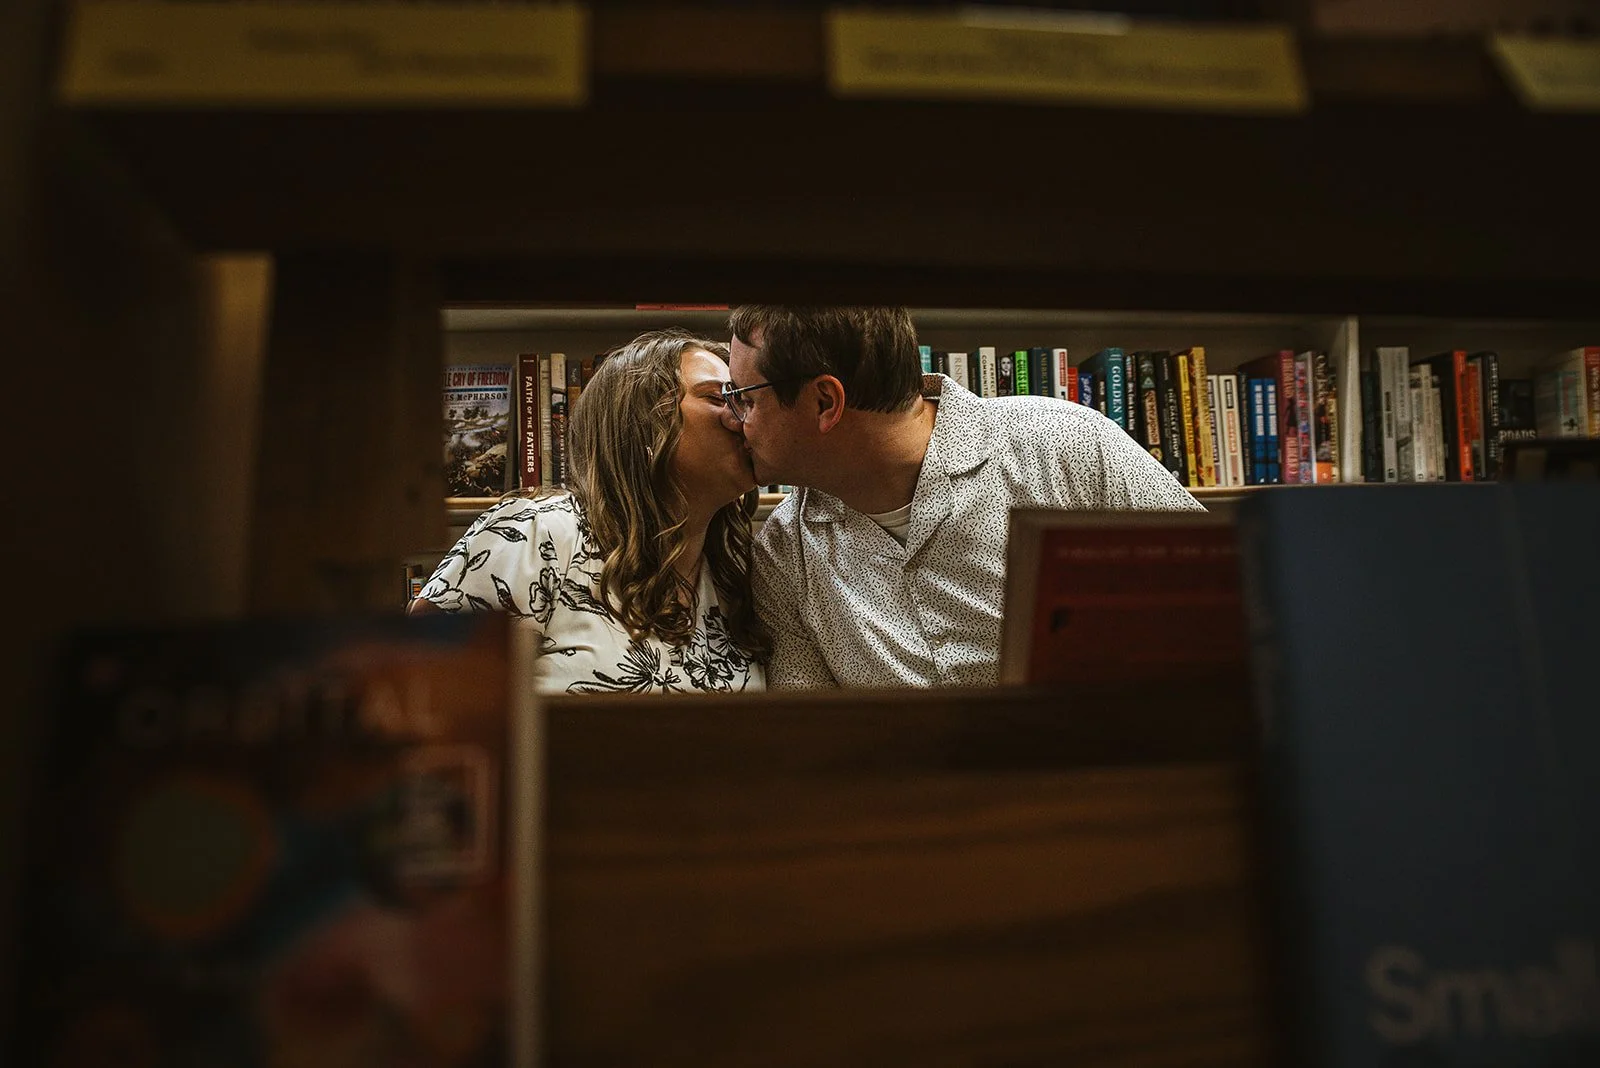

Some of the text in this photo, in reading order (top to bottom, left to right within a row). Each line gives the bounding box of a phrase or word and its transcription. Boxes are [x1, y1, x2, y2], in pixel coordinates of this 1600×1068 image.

[452, 372, 467, 387] CRY
[468, 372, 477, 387] OF
[477, 371, 510, 386] FREEDOM
[954, 357, 962, 385] RISIN
[1017, 359, 1027, 396] CULTS LIK
[457, 392, 508, 401] McPHERSON
[525, 376, 534, 404] FAITH
[1112, 365, 1122, 413] GOLDEN
[527, 405, 532, 415] OF
[526, 431, 535, 473] FATHERS
[1171, 433, 1179, 458] SHOW
